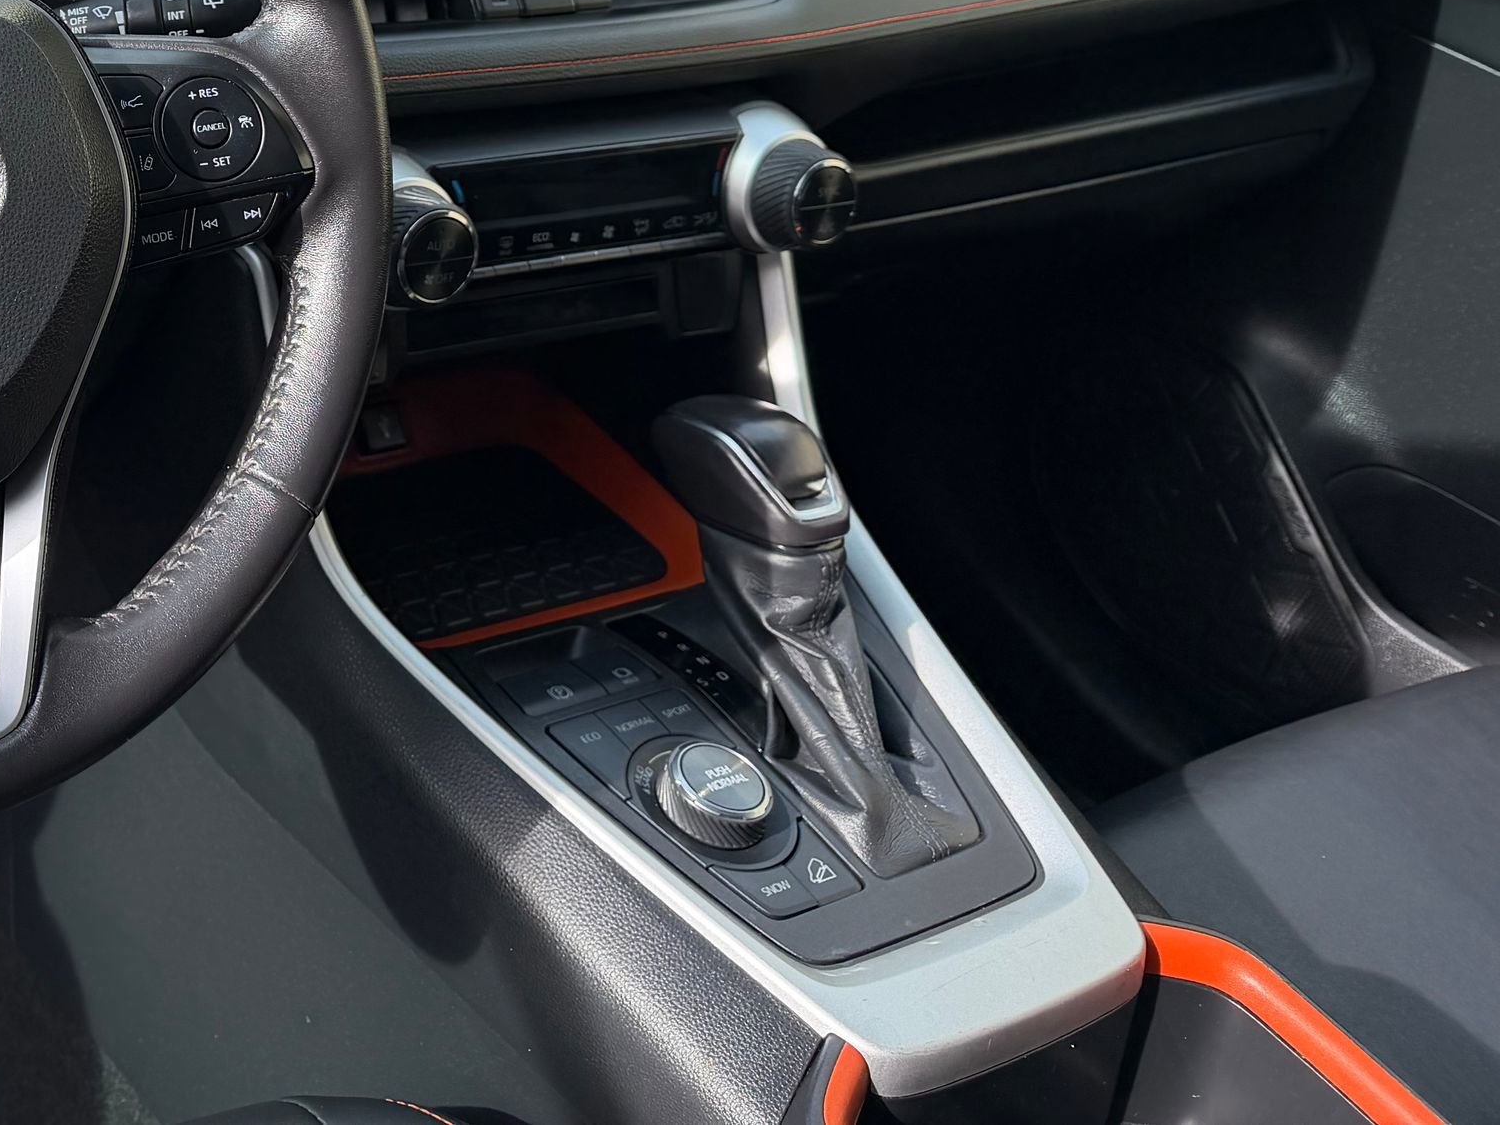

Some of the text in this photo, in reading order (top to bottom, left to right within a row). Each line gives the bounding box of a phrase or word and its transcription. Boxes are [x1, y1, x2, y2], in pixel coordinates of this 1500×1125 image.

[67, 6, 90, 16] MIST
[167, 10, 186, 21] INT
[70, 16, 88, 25] OFF
[71, 26, 88, 34] INT
[199, 87, 219, 99] RES
[196, 122, 227, 134] CANCEL
[212, 155, 232, 168] SET
[141, 231, 175, 245] MODE
[532, 231, 550, 242] ECO
[580, 730, 602, 744] ECO
[704, 764, 733, 780] PUSH
[760, 879, 792, 897] SNOW
